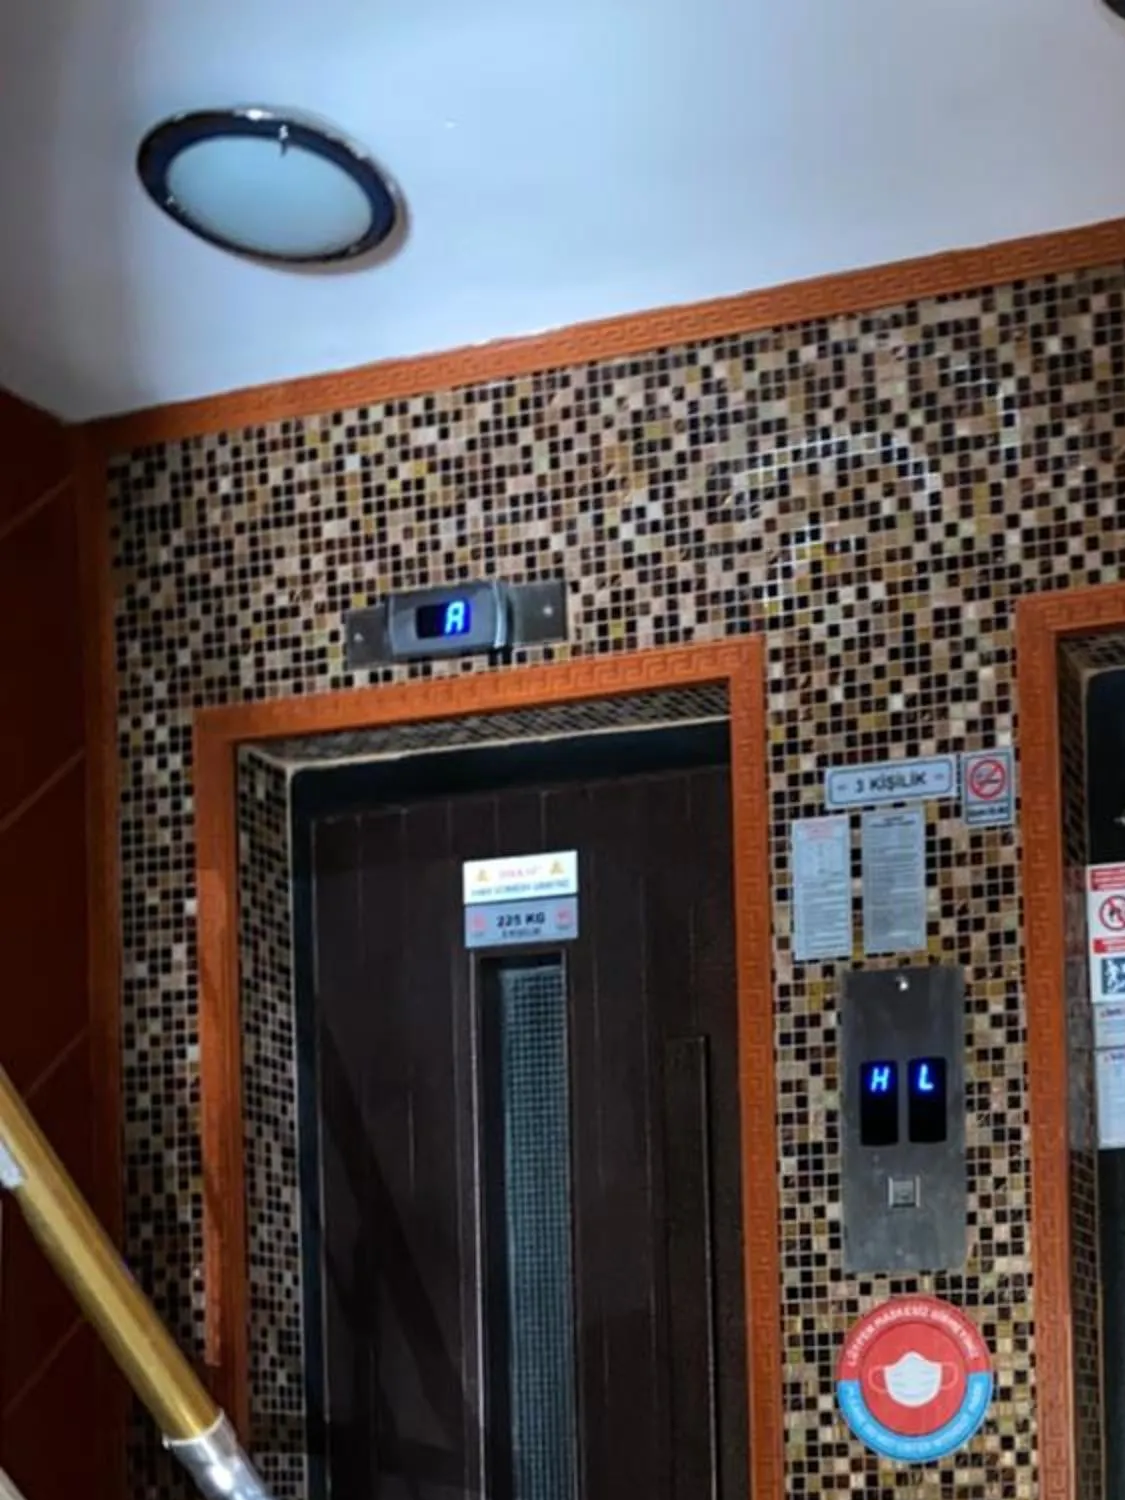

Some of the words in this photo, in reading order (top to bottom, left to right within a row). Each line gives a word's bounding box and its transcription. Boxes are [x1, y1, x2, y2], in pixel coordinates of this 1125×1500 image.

[444, 600, 466, 634] A
[855, 780, 865, 794] 3
[869, 769, 927, 792] KİŞİLİK
[496, 914, 521, 928] 225
[525, 911, 545, 925] KG
[870, 1066, 890, 1092] H
[918, 1064, 934, 1090] L
[846, 1322, 876, 1367] LÜTFEN
